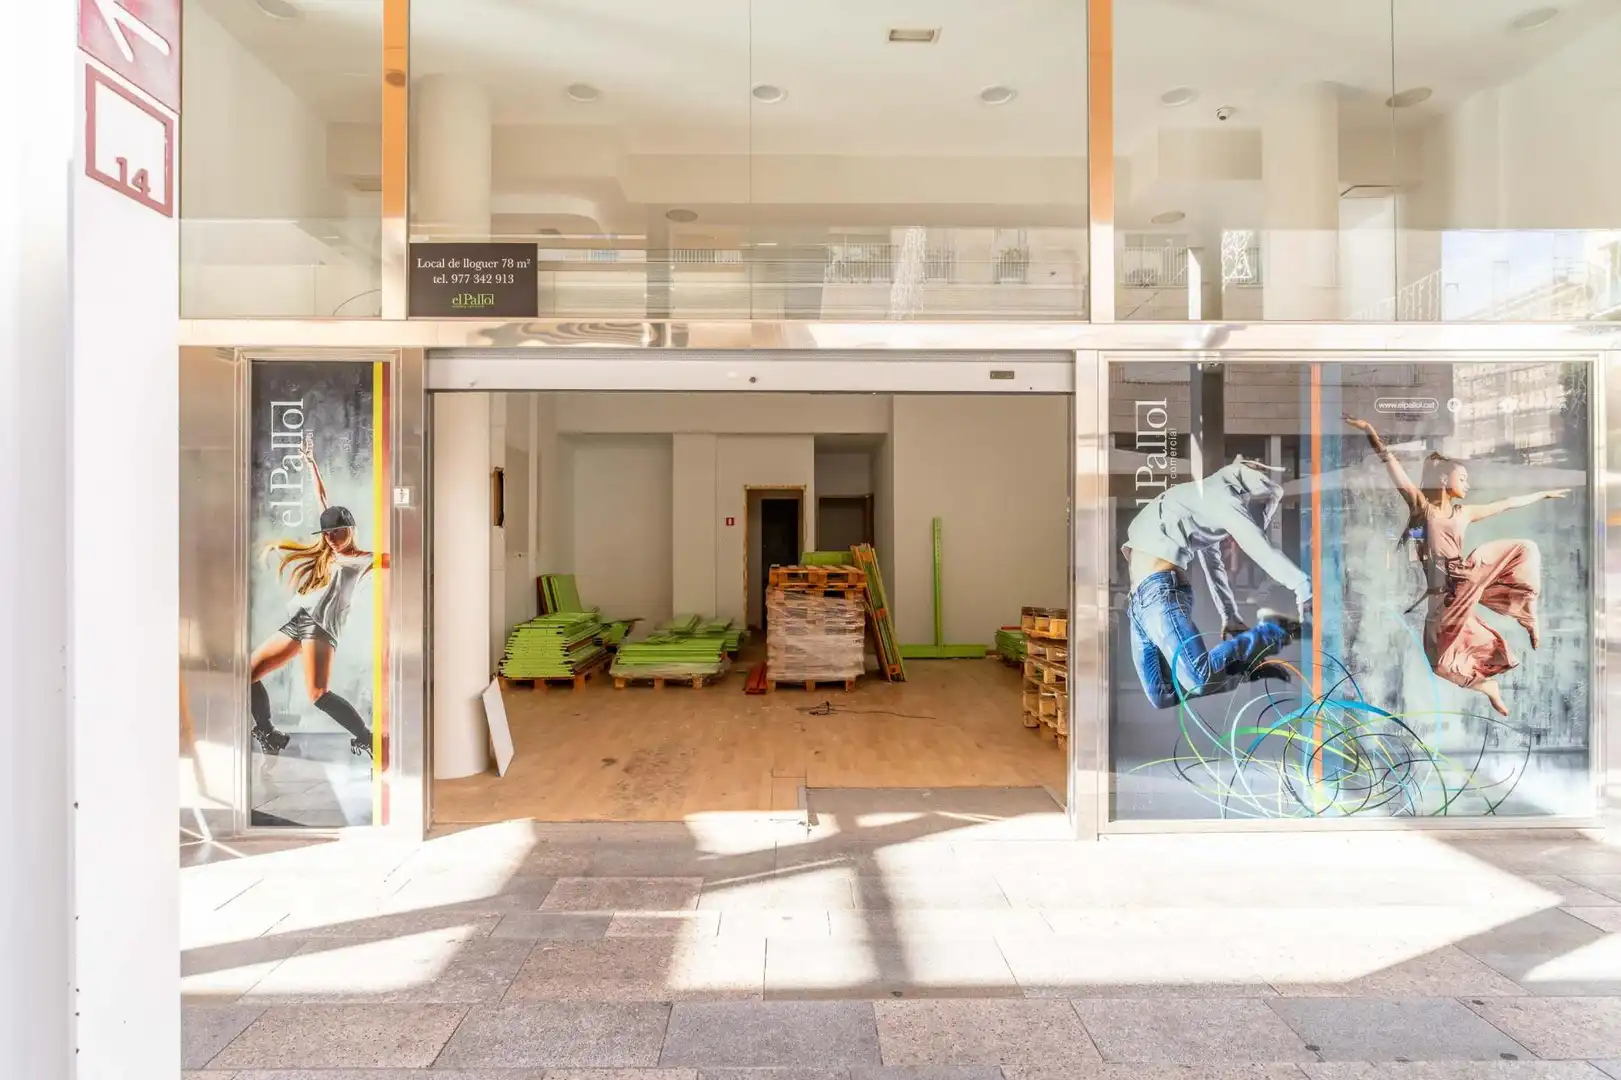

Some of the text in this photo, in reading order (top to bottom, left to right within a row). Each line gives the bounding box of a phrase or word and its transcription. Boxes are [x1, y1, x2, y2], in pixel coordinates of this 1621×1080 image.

[115, 157, 151, 197] 14
[417, 258, 445, 269] Local
[447, 258, 461, 269] de
[463, 258, 498, 271] lloguer
[501, 258, 514, 269] 78
[433, 274, 514, 284] tel. 977 342 913
[452, 293, 494, 305] el Pallol
[270, 398, 305, 528] el Pallol
[1135, 398, 1168, 492] Pallol
[1167, 427, 1178, 479] comercial
